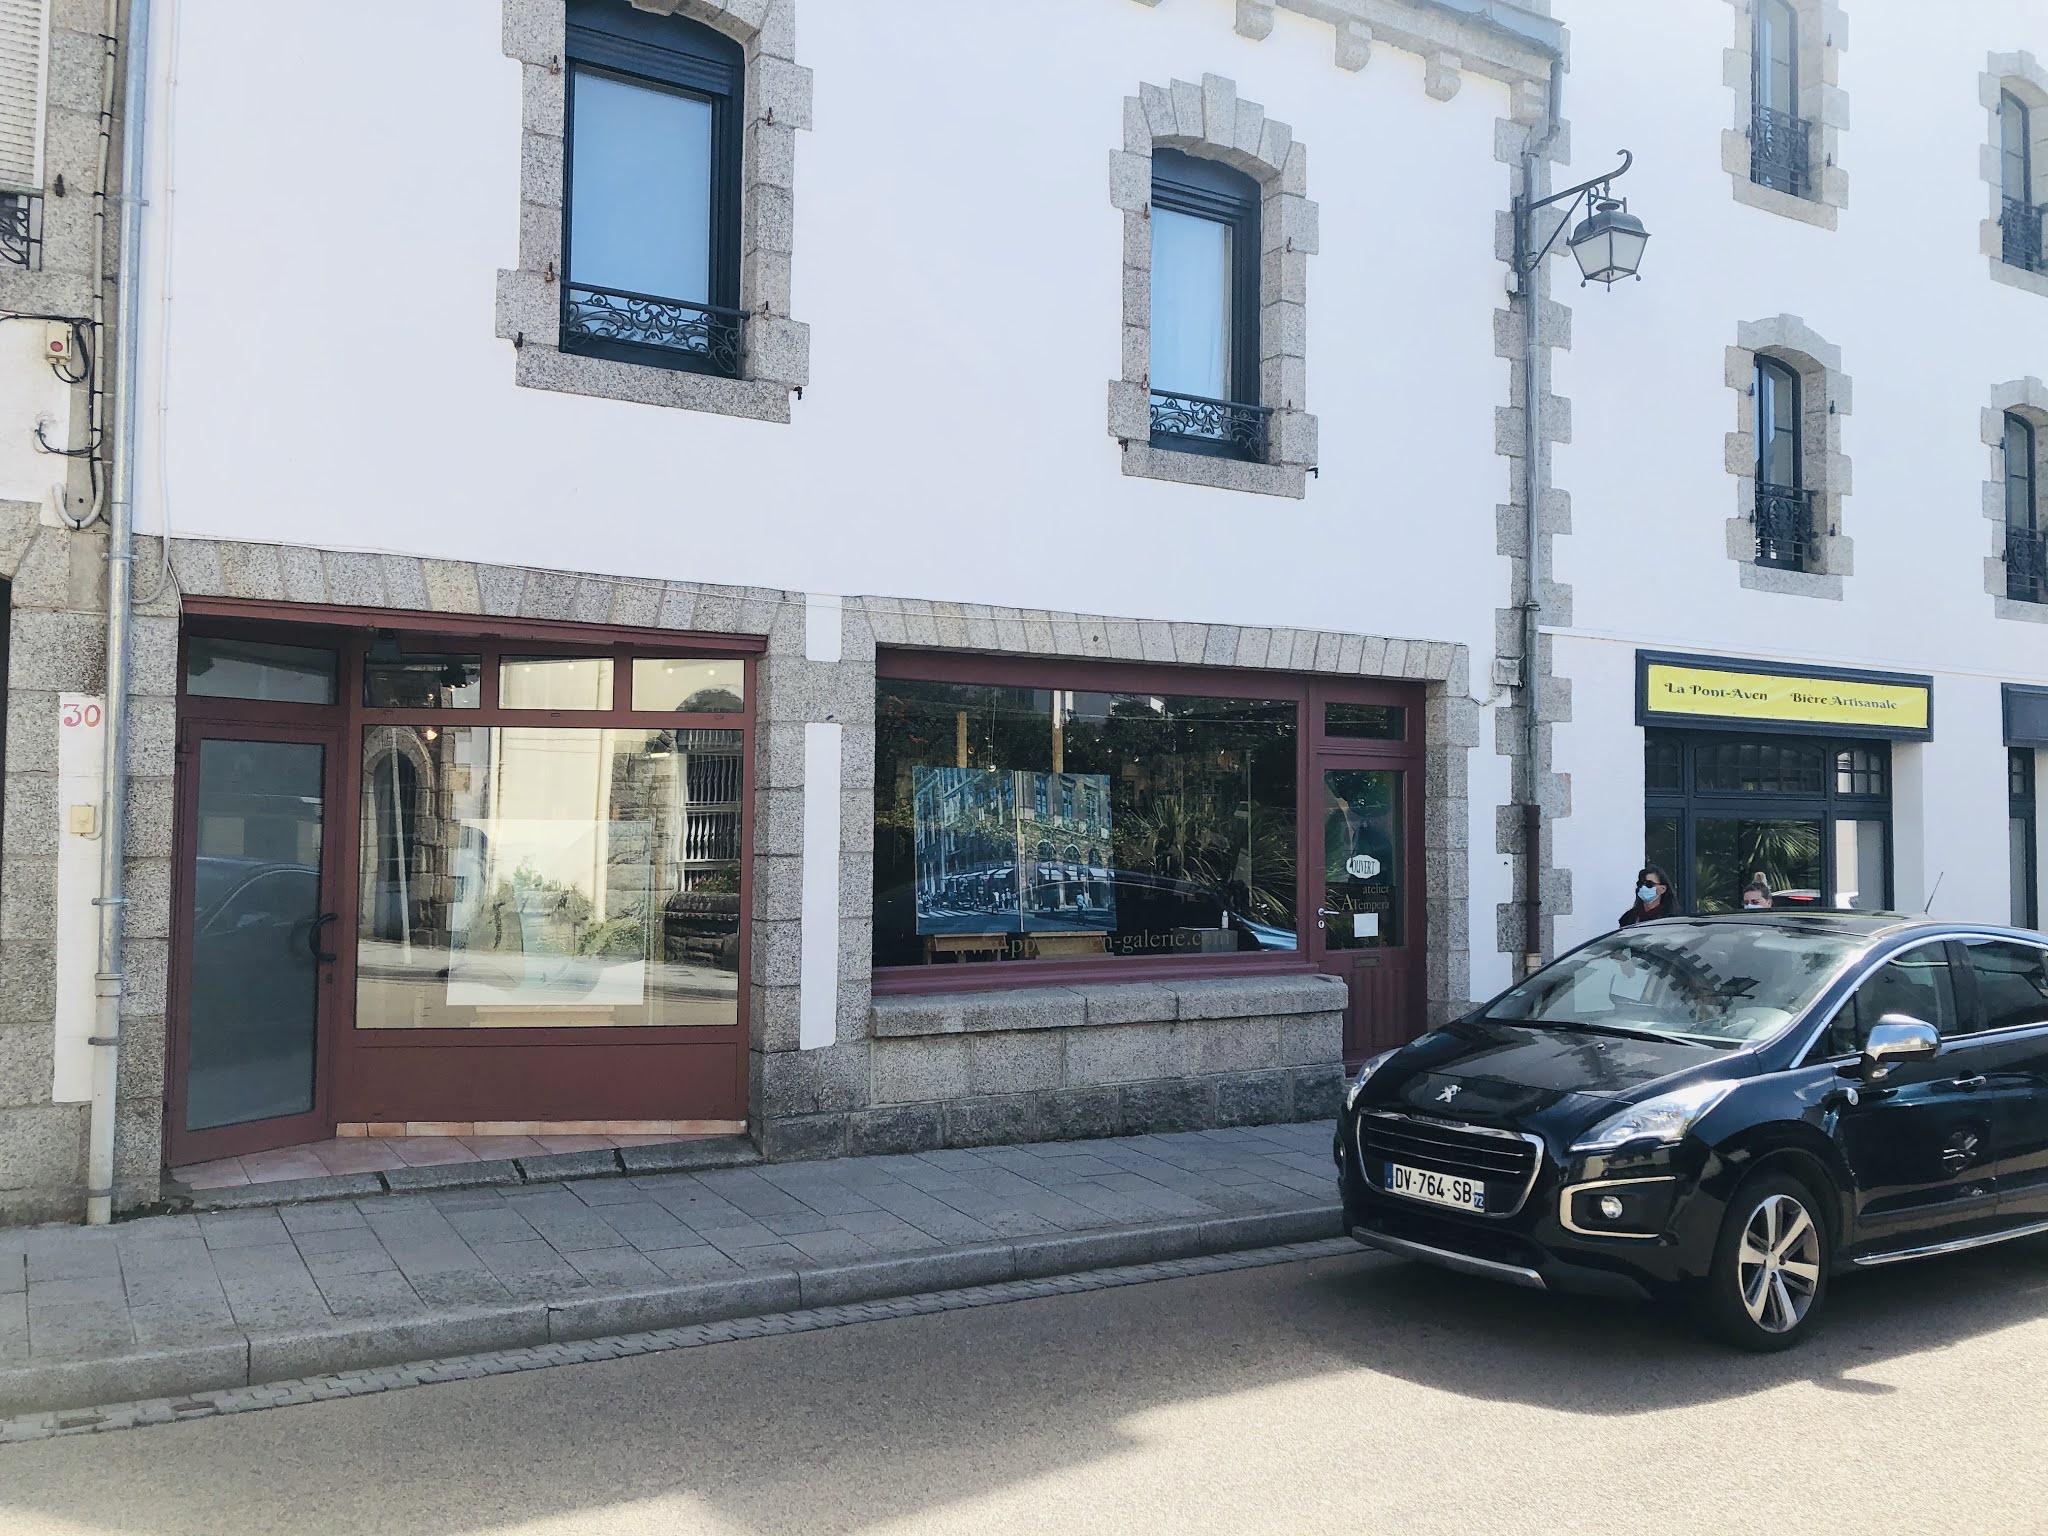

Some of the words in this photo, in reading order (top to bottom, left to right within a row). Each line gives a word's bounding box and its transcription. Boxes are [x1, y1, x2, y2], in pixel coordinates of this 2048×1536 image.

[1664, 682, 1685, 694] La
[1689, 684, 1768, 701] Pont-Aven
[1790, 692, 1828, 704] Bière
[1829, 695, 1897, 709] Artisanale
[63, 703, 101, 727] 30
[1352, 860, 1375, 874] OUVERT
[1362, 883, 1389, 894] atelier
[1395, 1167, 1472, 1203] DV-764-SB
[1474, 1194, 1484, 1207] 72
